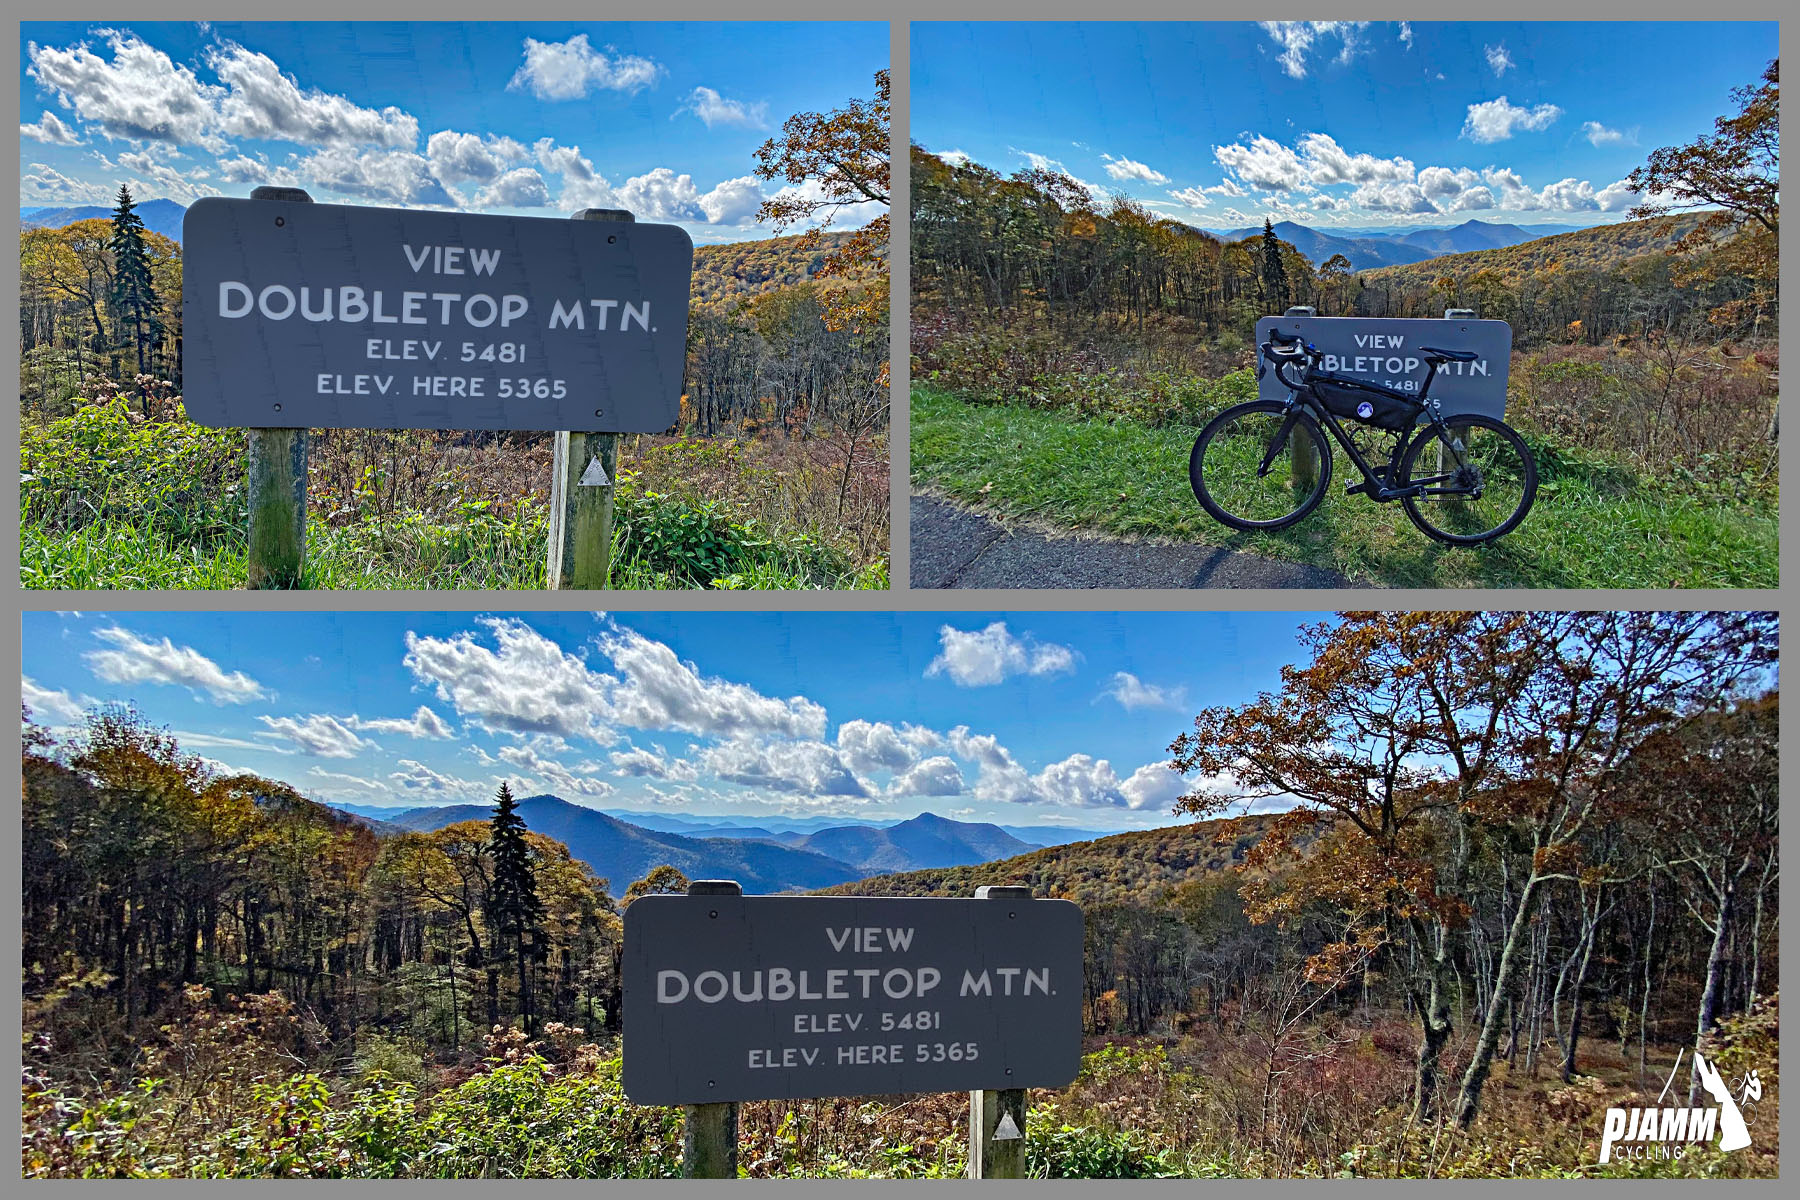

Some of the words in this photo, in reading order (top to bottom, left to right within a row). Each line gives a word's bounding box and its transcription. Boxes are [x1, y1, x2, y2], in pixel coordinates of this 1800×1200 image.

[403, 244, 501, 277] VIEW
[219, 281, 529, 328] DOUBLETOP
[548, 299, 658, 333] MTN.
[366, 338, 447, 361] ELEV.
[460, 342, 526, 363] 5481
[1354, 334, 1404, 349] VIEW
[1274, 353, 1420, 374] BLETOP
[317, 373, 400, 395] ELEV.
[413, 376, 485, 398] HERE
[497, 378, 567, 400] 5365
[1384, 379, 1419, 391] 5481
[825, 927, 915, 953] VIEW
[657, 967, 941, 1004] DOUBLETOP
[959, 967, 1057, 997] MTN.
[794, 1013, 868, 1033] ELEV.
[880, 1010, 940, 1032] 5481
[748, 1047, 825, 1069] ELEV.
[837, 1044, 904, 1065] HERE
[916, 1041, 979, 1063] 5365
